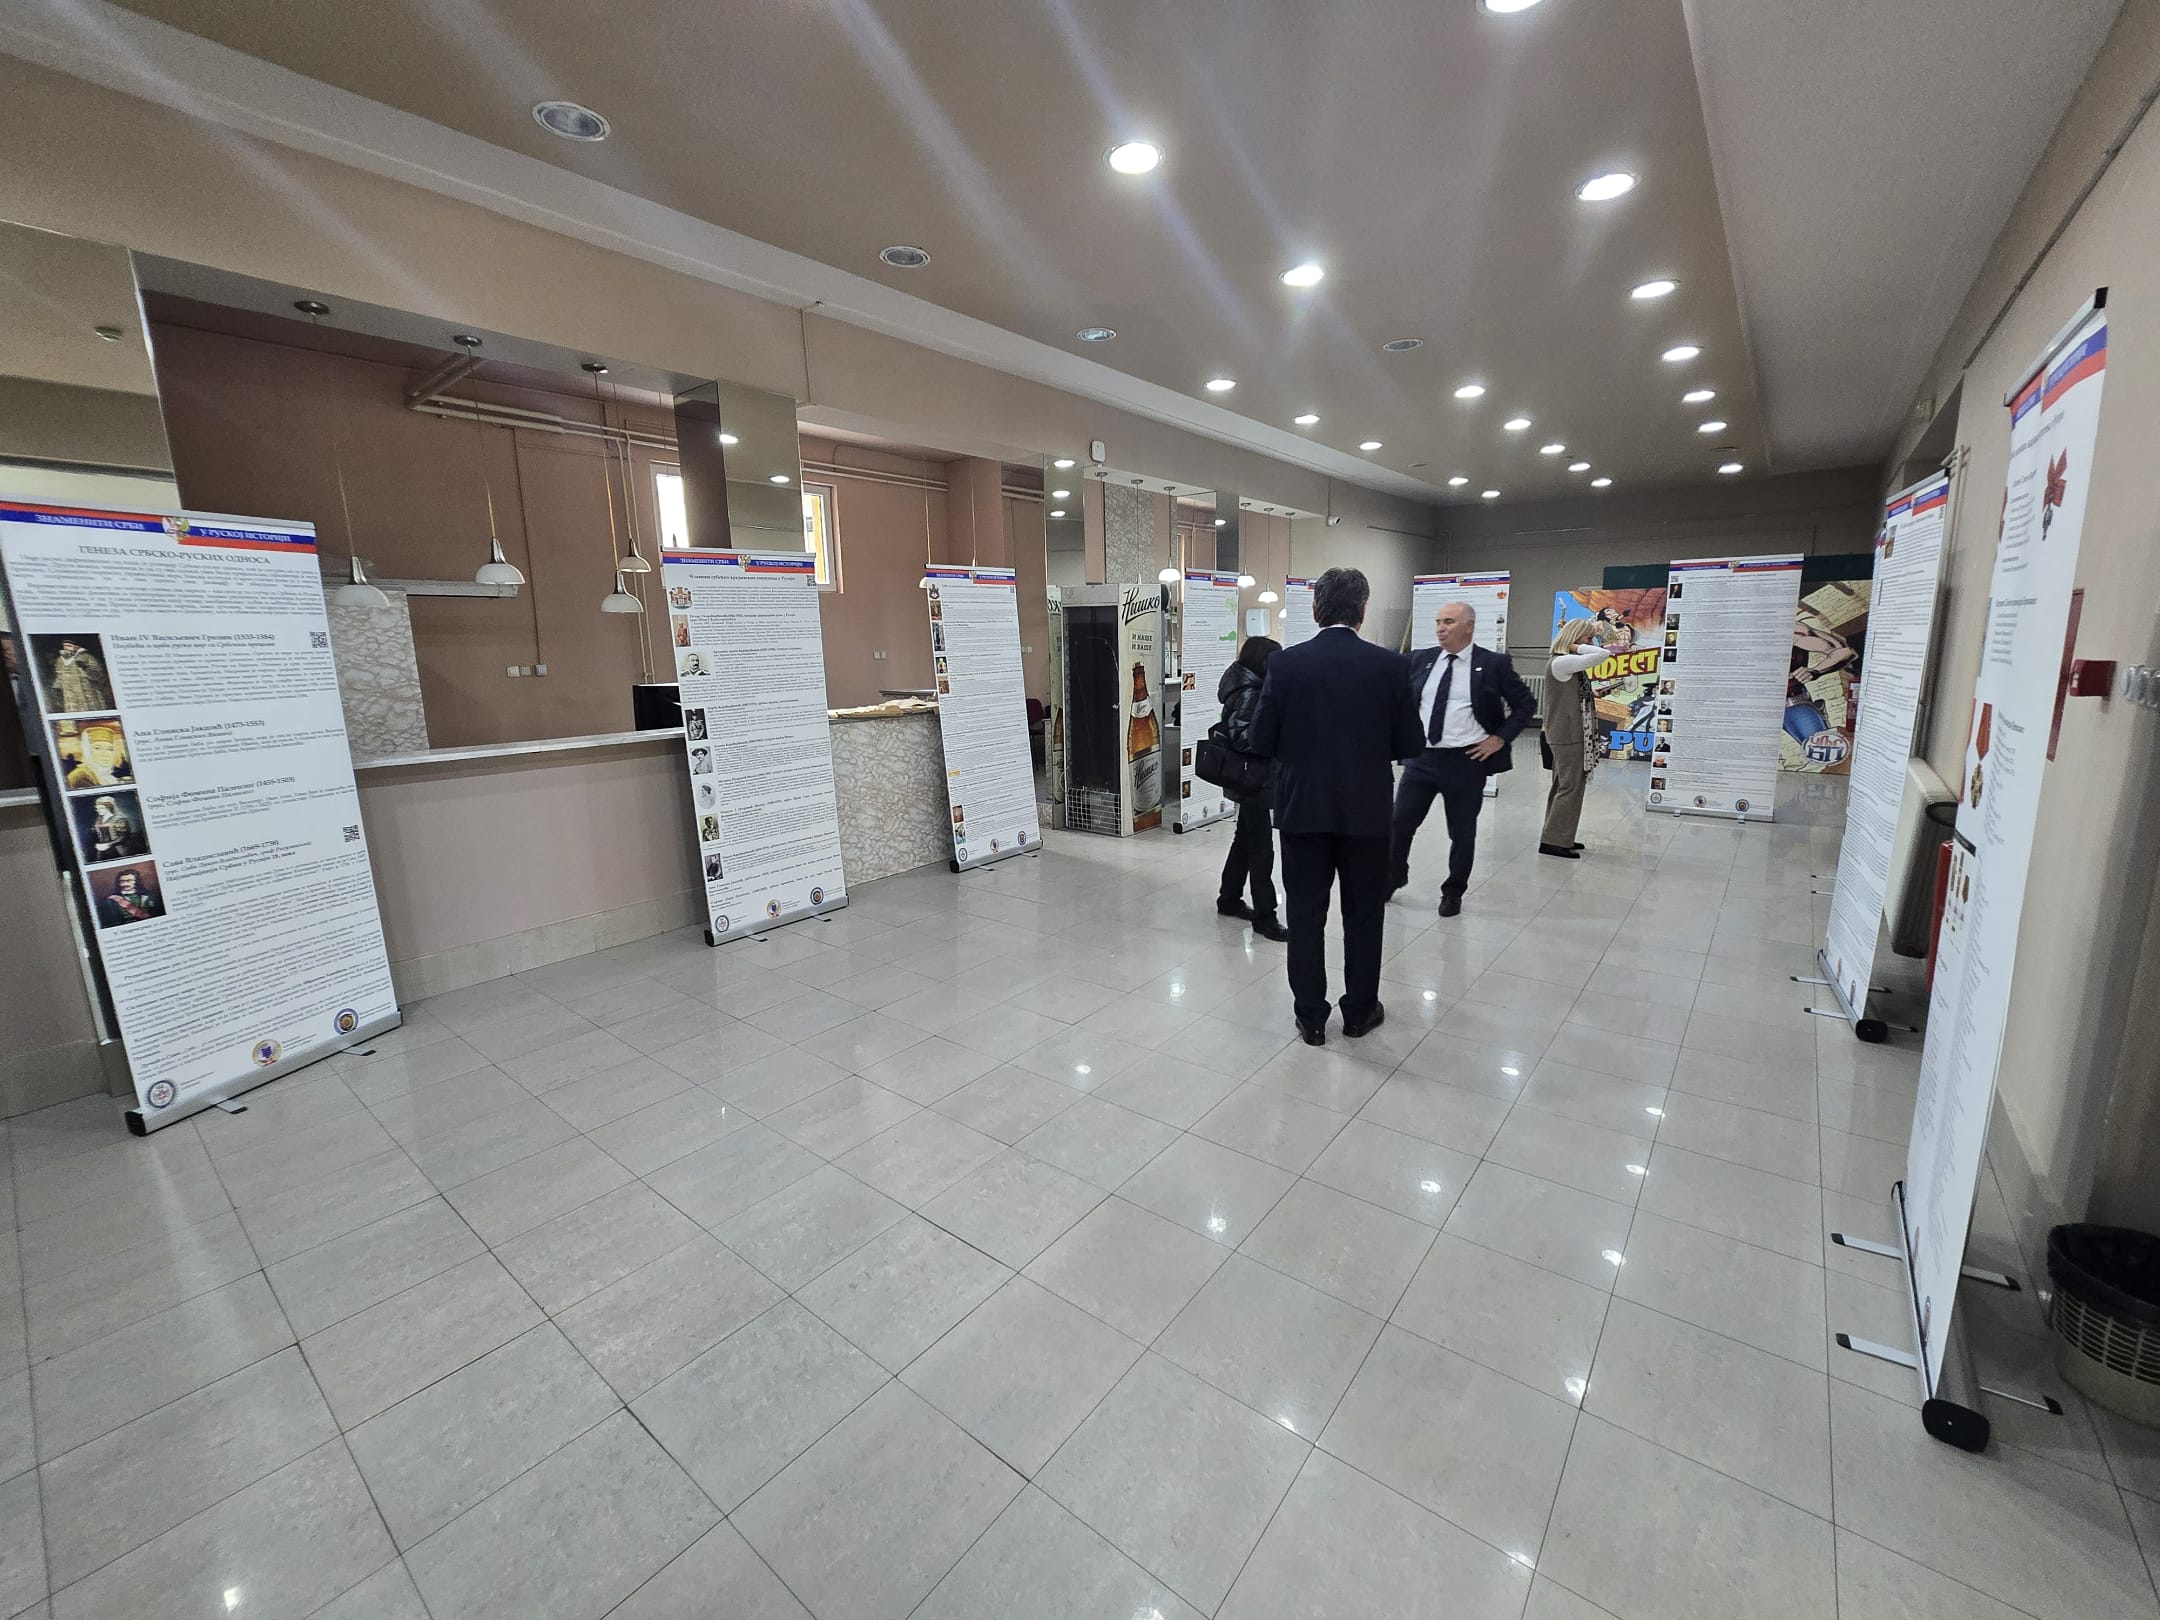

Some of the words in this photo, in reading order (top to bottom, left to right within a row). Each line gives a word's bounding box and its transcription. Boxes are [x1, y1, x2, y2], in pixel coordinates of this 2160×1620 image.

[34, 514, 114, 528] ЗНАМЕНИТИ
[114, 521, 145, 530] СРБИ
[209, 529, 244, 539] РУСКОЈ
[79, 545, 128, 556] ГЕНЕЗА
[129, 548, 224, 561] СРБСКО-РУСКИХ
[226, 554, 270, 564] ОДНОСА
[1121, 587, 1160, 625] Нишко
[1137, 632, 1153, 642] НАШЕ
